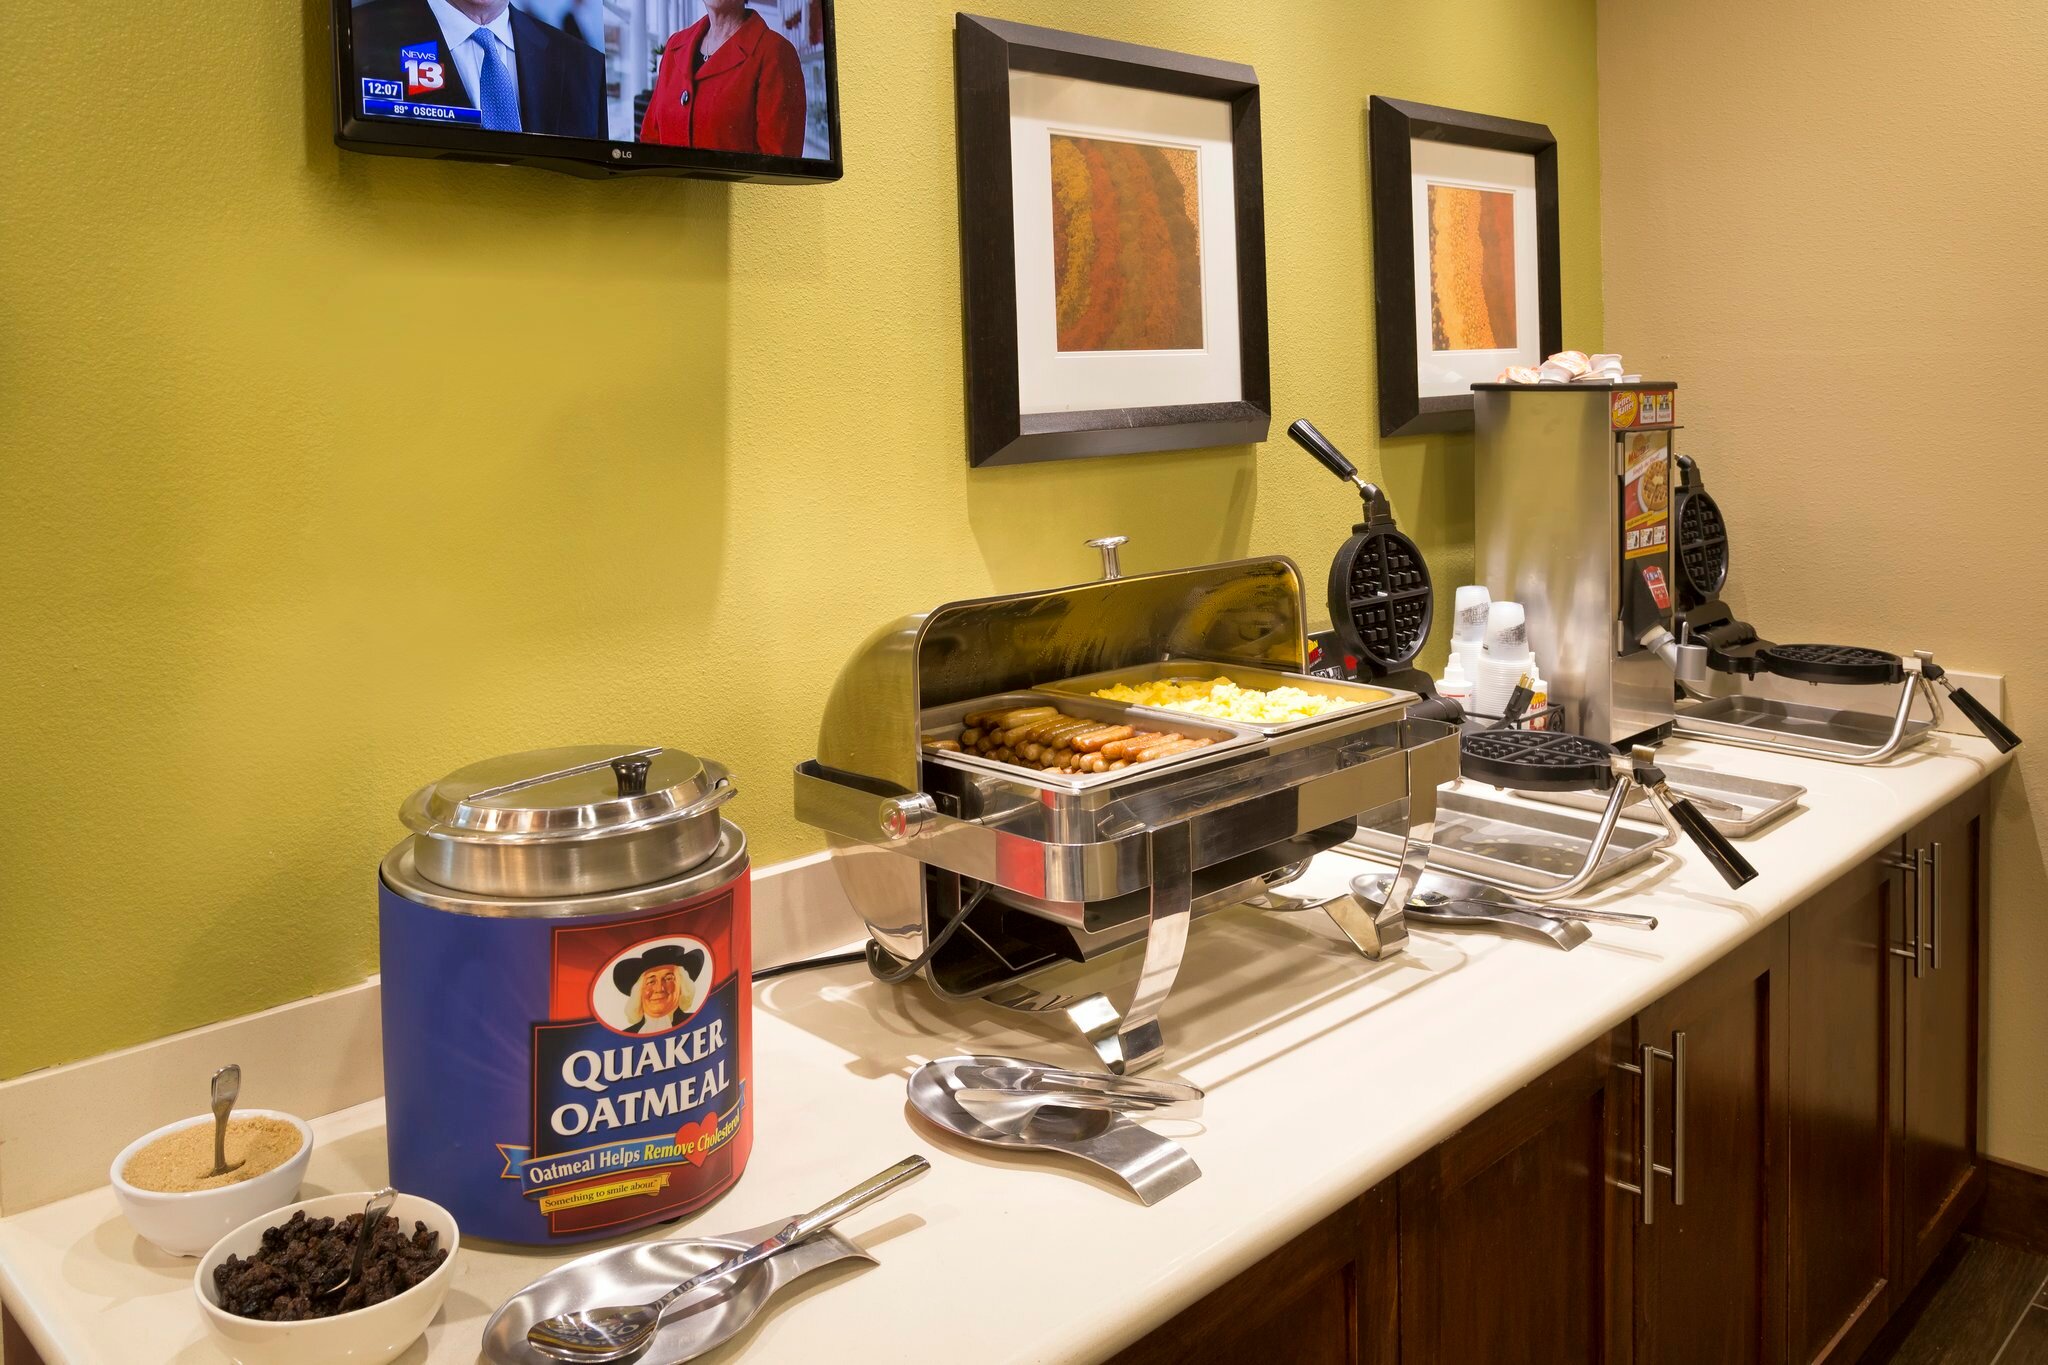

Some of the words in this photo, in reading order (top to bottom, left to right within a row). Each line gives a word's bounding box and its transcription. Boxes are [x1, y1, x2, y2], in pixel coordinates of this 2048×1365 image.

[401, 49, 436, 60] NEWS
[404, 60, 444, 88] 13
[368, 82, 398, 96] 12:07
[394, 105, 409, 115] 89°
[413, 106, 455, 119] OSCEOLA
[622, 150, 632, 159] LG
[562, 1018, 725, 1092] QUAKER
[551, 1059, 730, 1136] OATMEAL
[530, 1153, 595, 1184] Oatmeal
[600, 1147, 640, 1168] Helps
[644, 1141, 695, 1160] Remove
[545, 1191, 594, 1208] Something
[596, 1188, 605, 1197] to
[607, 1184, 628, 1195] smile
